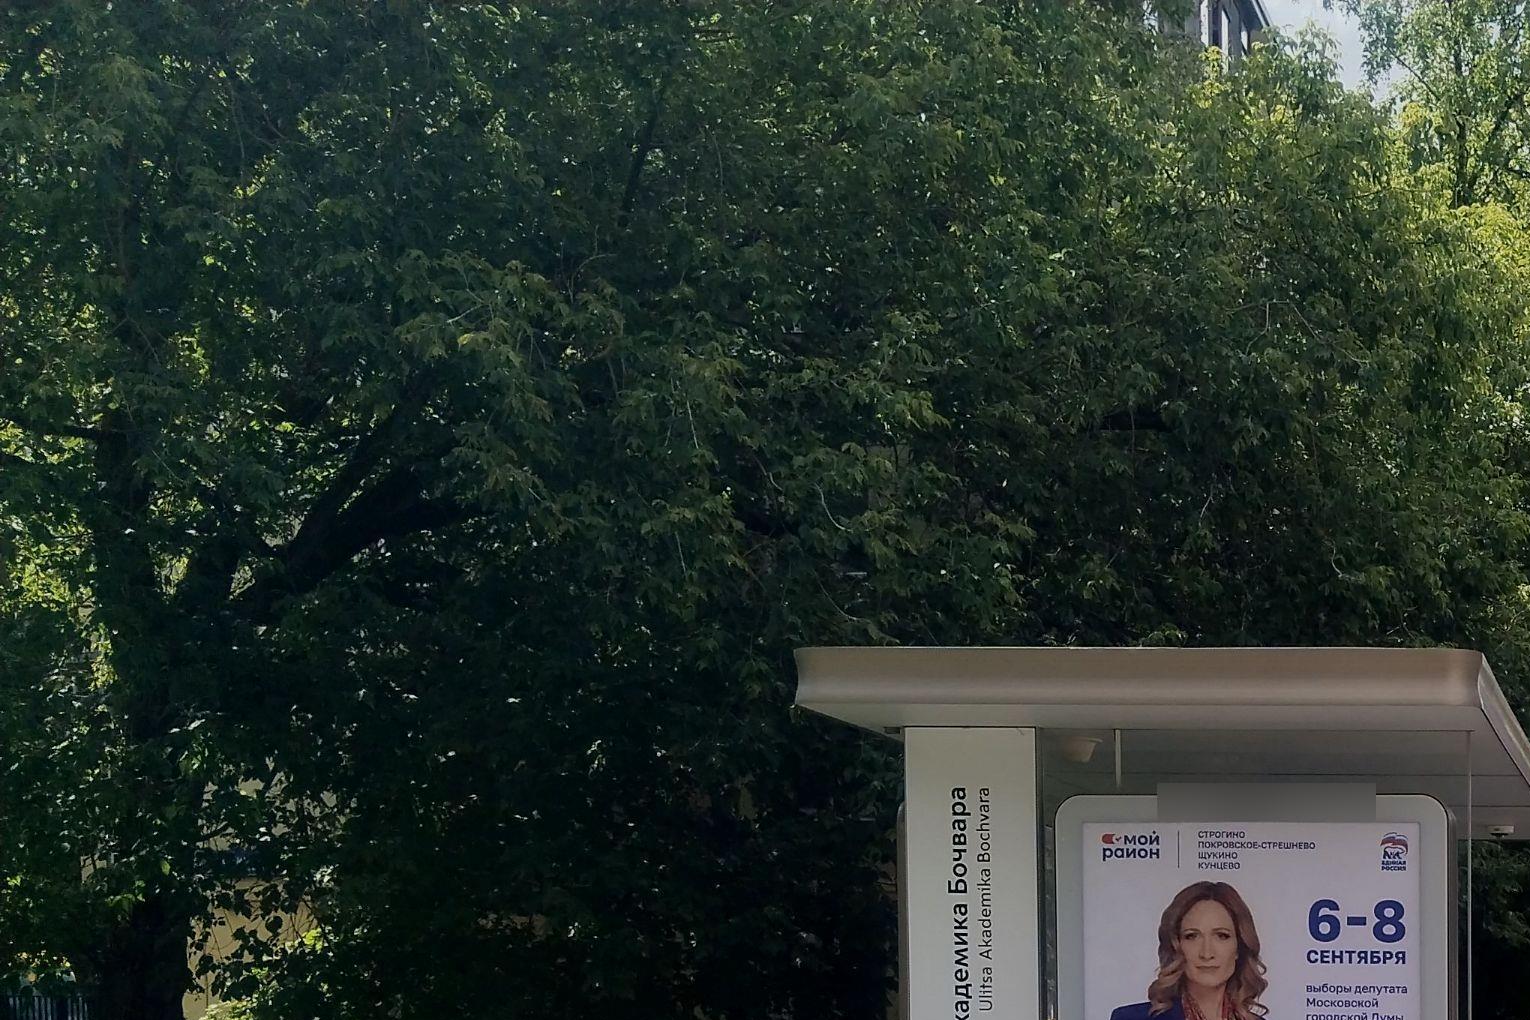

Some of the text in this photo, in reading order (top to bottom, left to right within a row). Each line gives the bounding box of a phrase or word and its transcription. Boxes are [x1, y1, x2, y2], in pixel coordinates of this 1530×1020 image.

[947, 786, 972, 895] Бочвара
[1123, 830, 1160, 846] мой
[1198, 830, 1245, 839] СТРОГИНО
[1198, 840, 1316, 850] ПОКРОВСКОЕ-СТРЕШНЕВО
[1102, 846, 1160, 861] район
[1198, 851, 1238, 861] ЩУКИНО
[1198, 861, 1241, 871] КУНЦЕВО
[976, 787, 994, 1012] Ulitsa Akademika Bochvara
[1306, 950, 1406, 965] СЕНТЯБРЯ
[1306, 984, 1408, 997] выборы депутата
[1306, 997, 1379, 1009] Московской
